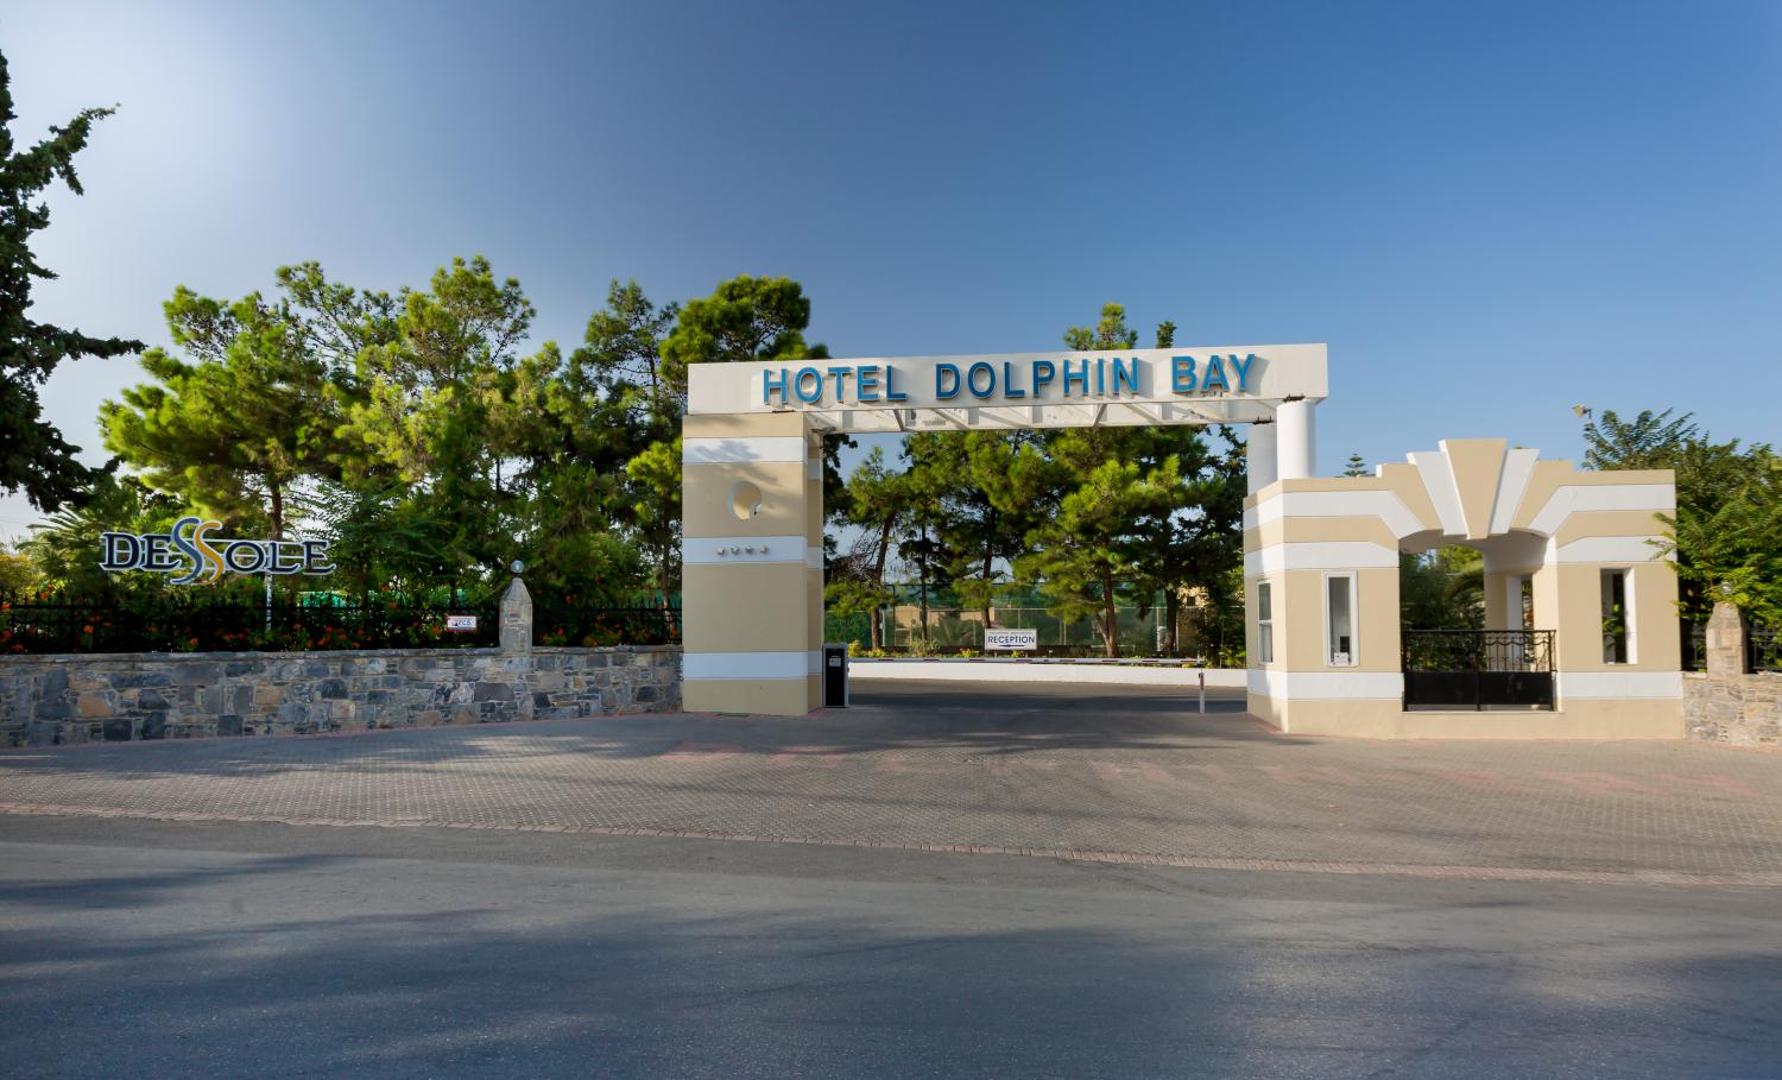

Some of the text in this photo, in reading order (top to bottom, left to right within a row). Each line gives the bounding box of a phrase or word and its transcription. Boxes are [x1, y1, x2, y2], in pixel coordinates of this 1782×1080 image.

[763, 353, 1256, 404] HOTEL DOLPHIN BAY
[100, 516, 337, 586] DESSOLE
[987, 635, 1035, 644] RECEPTION
